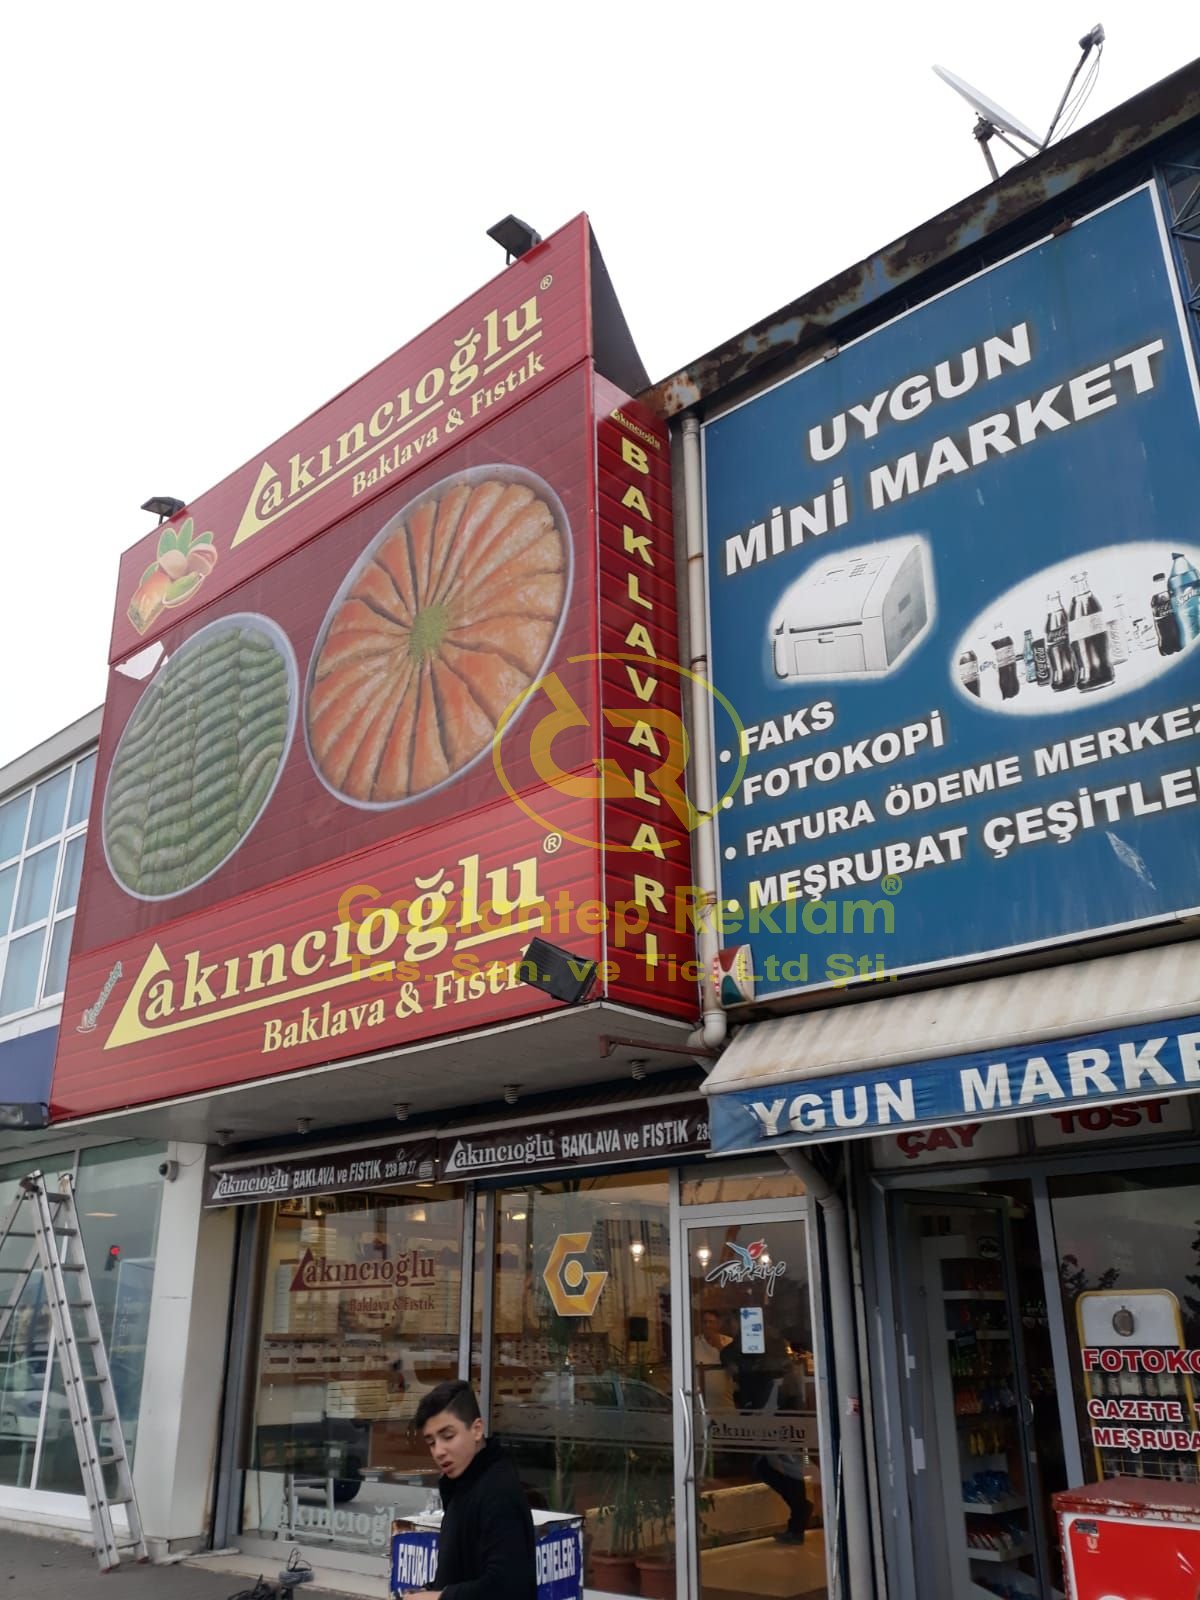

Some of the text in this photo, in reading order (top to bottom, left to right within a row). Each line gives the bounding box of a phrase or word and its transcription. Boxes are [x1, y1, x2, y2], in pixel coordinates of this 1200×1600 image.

[809, 322, 1031, 461] UYGUN
[351, 351, 545, 498] Baklava & Fıstık
[725, 339, 1165, 576] MİNİ MARKET
[740, 701, 835, 756] FAKS
[743, 710, 945, 805] FOTOKOPİ
[746, 800, 874, 856] FATURA
[884, 756, 1022, 816] ÖDEME
[750, 766, 1200, 910] MEŞRUBAT ÇEŞİTLE
[262, 1002, 385, 1053] Baklava
[395, 981, 423, 1017] &
[744, 1078, 916, 1137] YGUN
[1053, 1098, 1170, 1134] TOST
[562, 1128, 620, 1158] BAKLAVA
[623, 1131, 638, 1149] ve
[642, 1119, 689, 1148] FISTIK
[896, 1123, 981, 1160] ÇAY
[293, 1166, 334, 1190] BAKLAVA
[337, 1168, 347, 1184] ve
[350, 1160, 381, 1183] FISTIK
[705, 1260, 788, 1297] Türkiye
[1087, 1400, 1184, 1423] GAZETE
